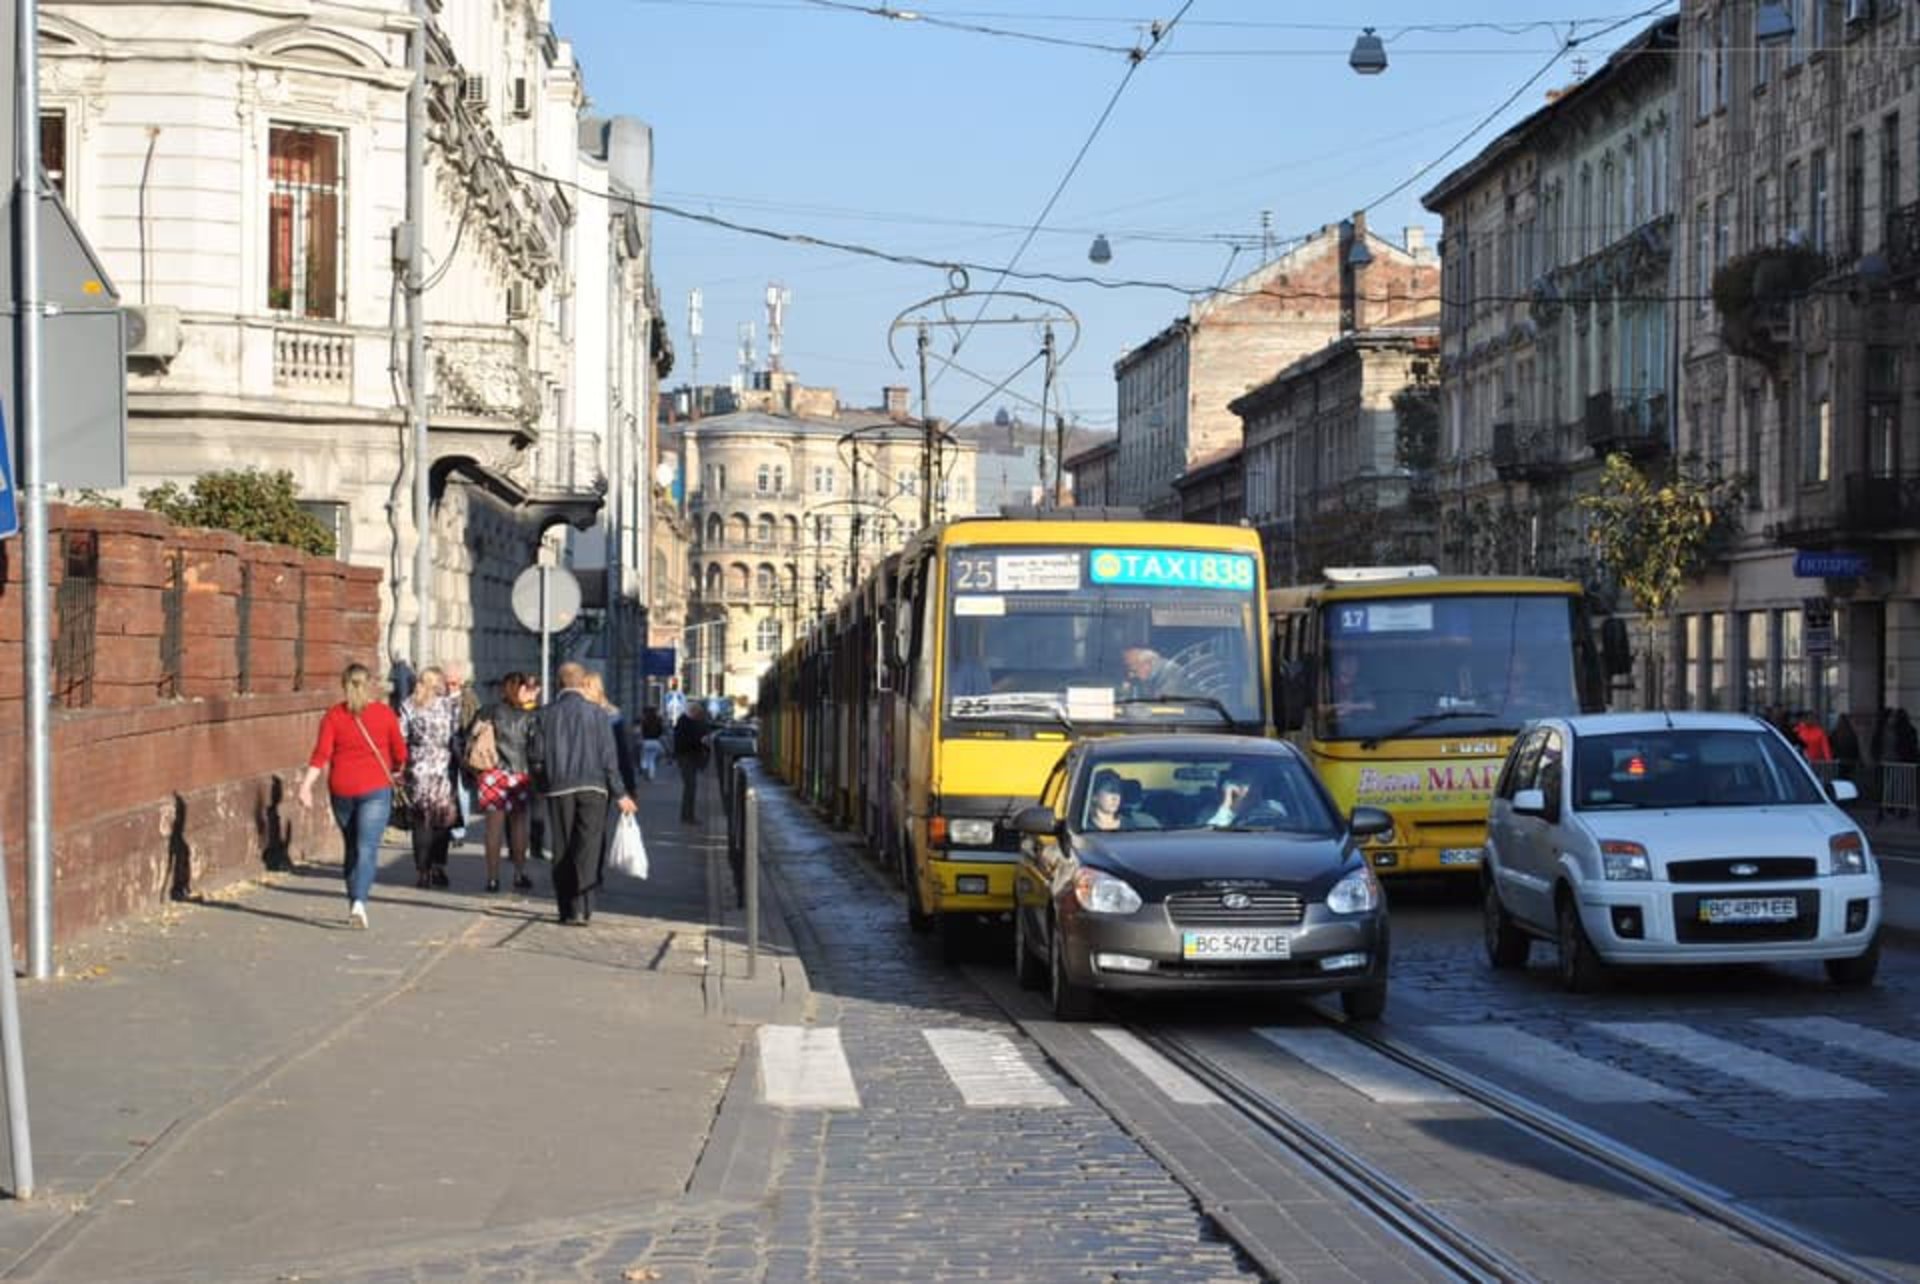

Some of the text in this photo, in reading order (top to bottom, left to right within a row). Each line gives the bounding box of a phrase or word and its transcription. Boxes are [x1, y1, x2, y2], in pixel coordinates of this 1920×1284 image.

[957, 560, 993, 588] 25
[1121, 555, 1250, 585] TAXI 838
[957, 699, 990, 715] 25
[1197, 935, 1287, 953] BC 5472 CE
